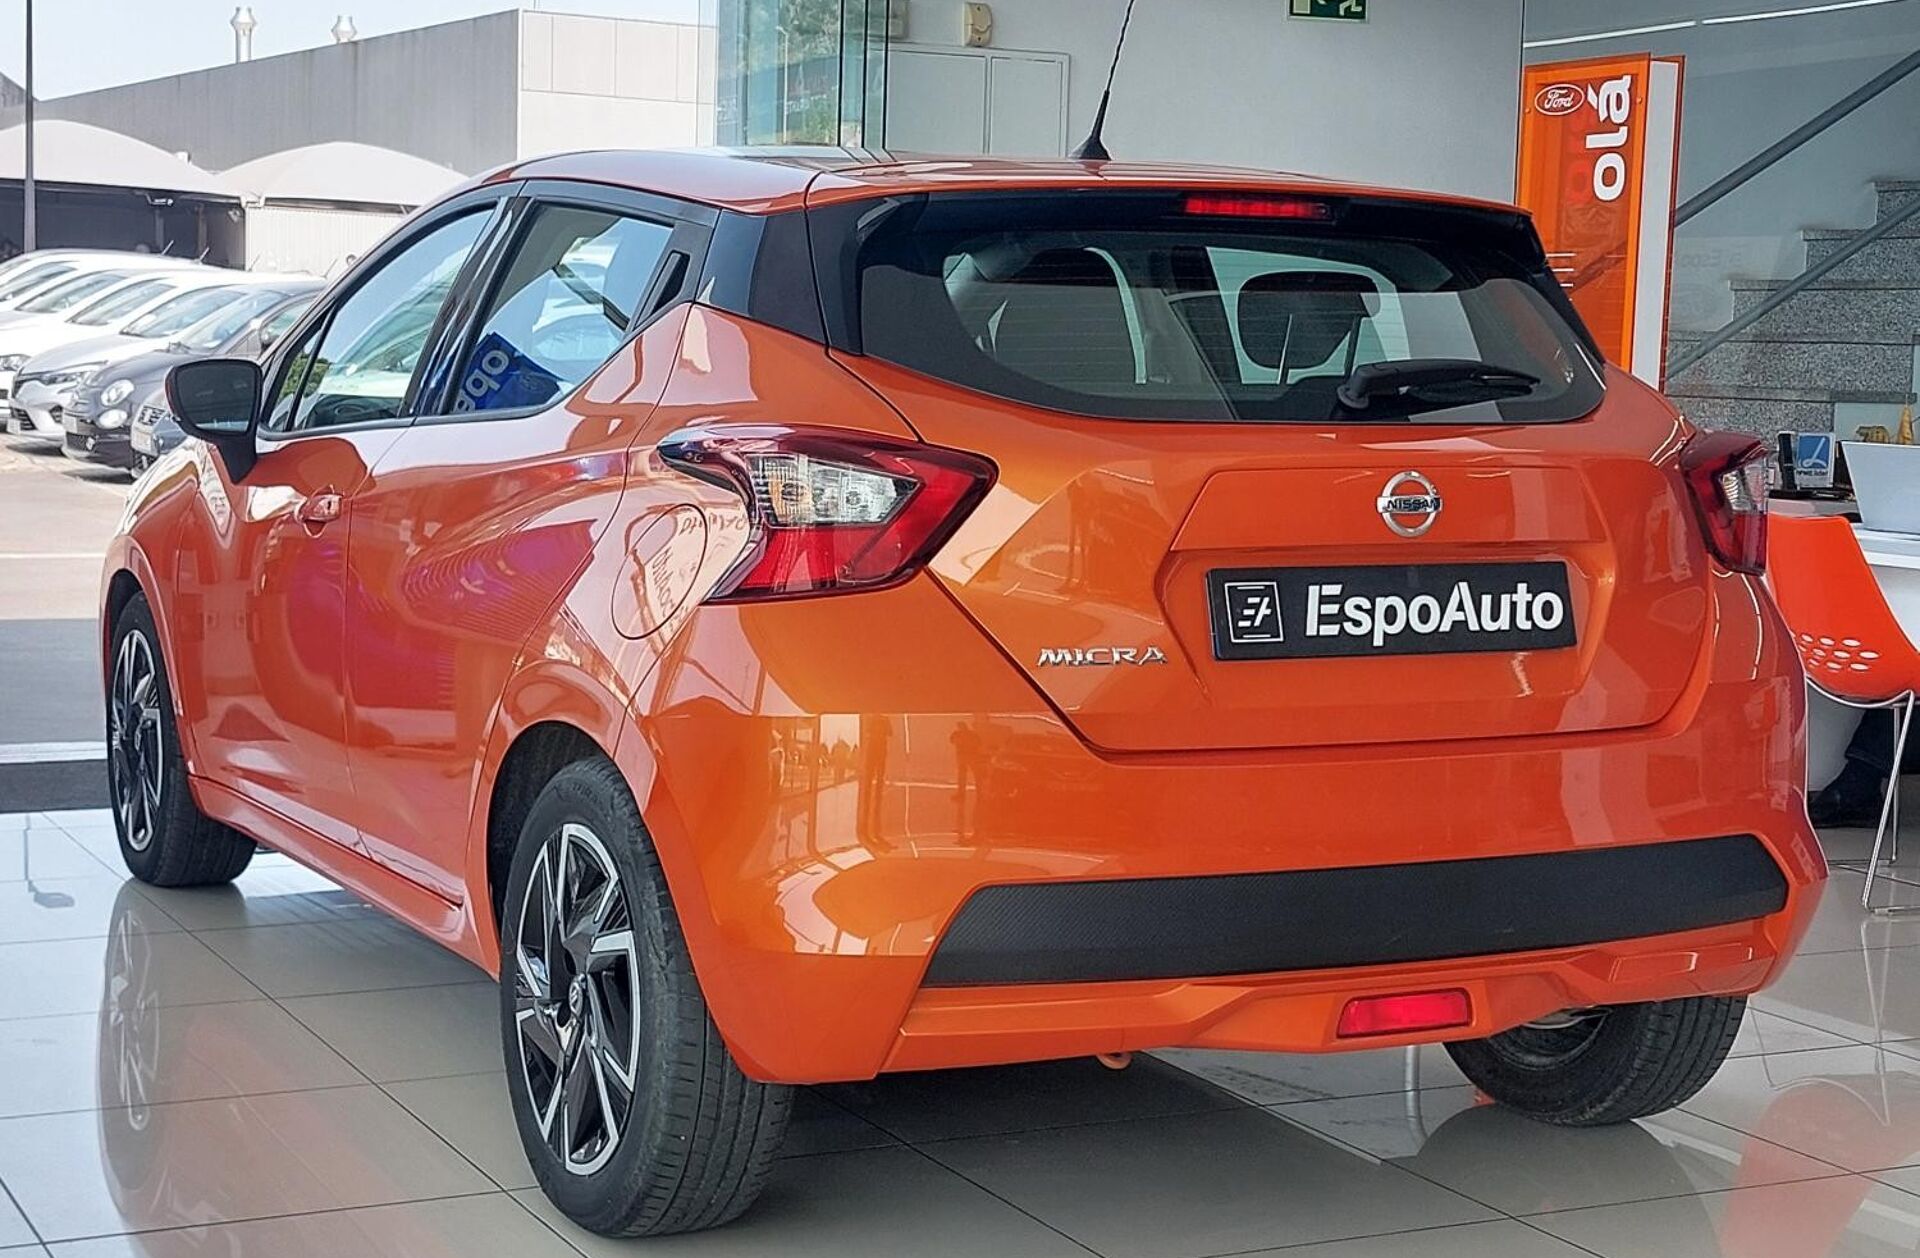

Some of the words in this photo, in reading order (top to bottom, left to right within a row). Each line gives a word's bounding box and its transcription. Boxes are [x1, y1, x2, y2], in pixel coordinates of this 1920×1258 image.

[1586, 75, 1631, 200] olá
[1387, 498, 1438, 511] NISSAN
[1305, 582, 1564, 647] EspoAuto
[1037, 646, 1168, 666] MICRA
